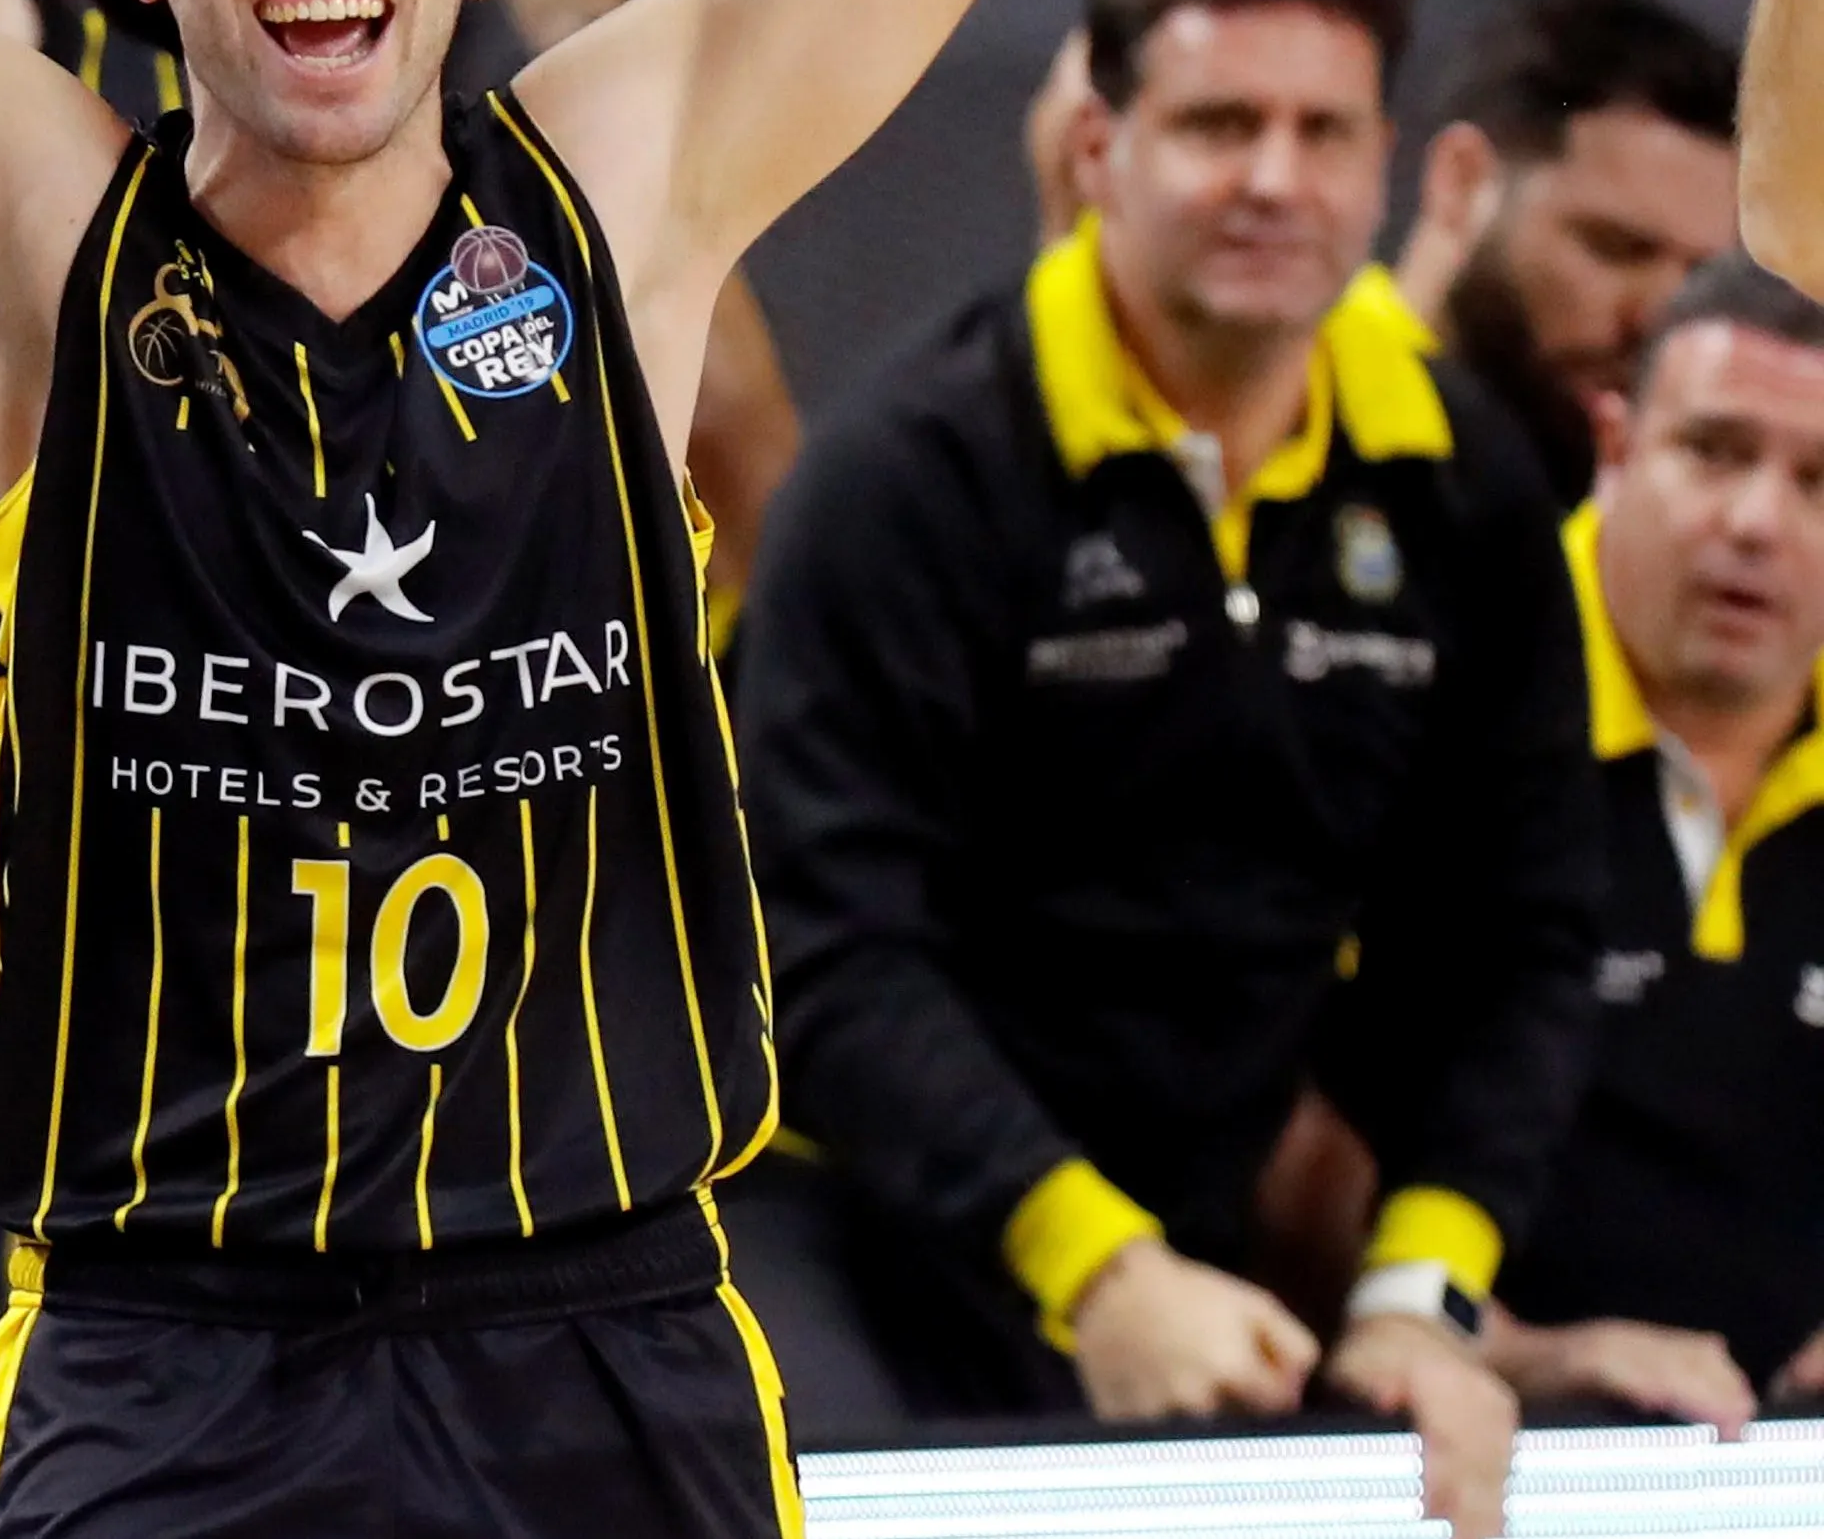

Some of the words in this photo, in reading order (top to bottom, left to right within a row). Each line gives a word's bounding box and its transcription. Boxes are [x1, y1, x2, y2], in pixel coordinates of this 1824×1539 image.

[447, 306, 511, 339] MADRID
[447, 325, 524, 368] COPA
[475, 334, 555, 390] REY
[92, 619, 631, 737] IBEROSTAR
[111, 756, 322, 809] HOTELS
[355, 778, 390, 812] &
[291, 851, 490, 1058] 10
